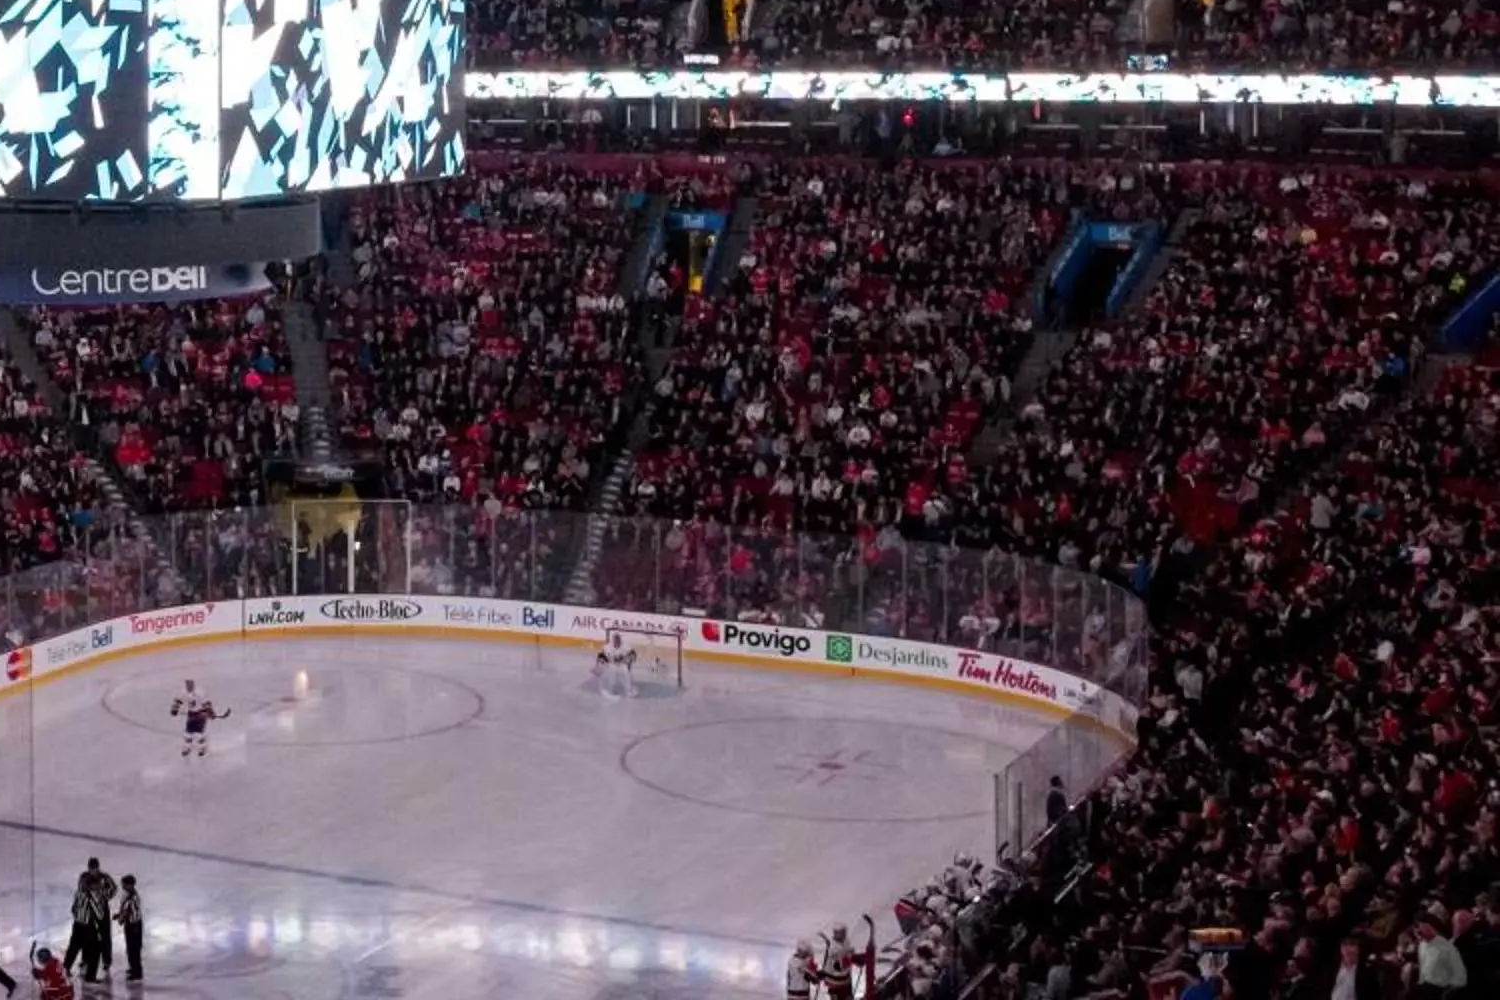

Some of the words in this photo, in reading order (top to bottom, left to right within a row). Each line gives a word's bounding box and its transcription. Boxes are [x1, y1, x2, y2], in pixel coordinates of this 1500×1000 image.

[128, 609, 207, 636] Tangerine
[334, 600, 412, 620] Techo-Bloc
[522, 606, 556, 630] Bell
[571, 614, 598, 631] AIR
[91, 625, 113, 650] Bell
[725, 624, 812, 656] Provigo
[859, 643, 950, 670] Desjardins
[958, 652, 992, 683] Tim
[994, 659, 1058, 701] Hortons
